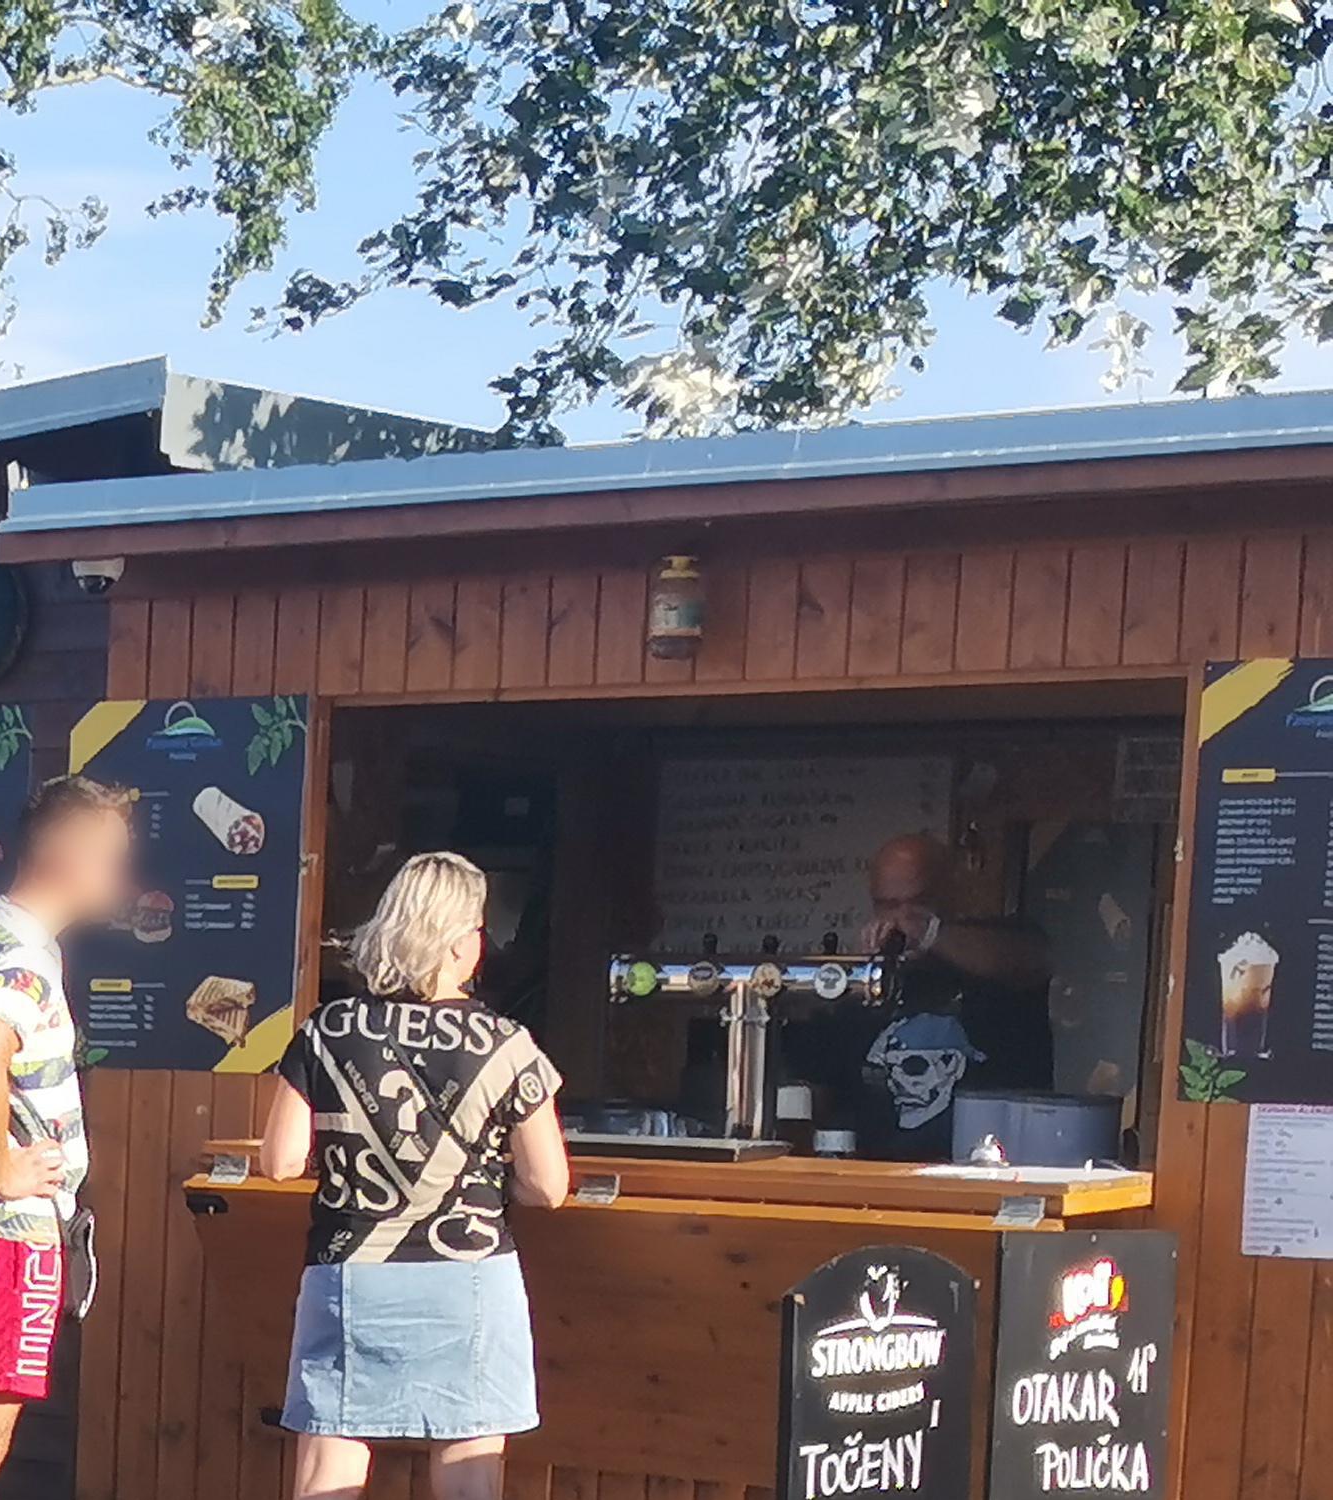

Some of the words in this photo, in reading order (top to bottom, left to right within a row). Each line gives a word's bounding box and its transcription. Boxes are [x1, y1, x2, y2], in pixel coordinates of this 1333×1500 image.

[320, 997, 495, 1055] GUESS
[811, 1329, 946, 1377] STRONGBOW
[1013, 1369, 1120, 1427] OTAKAR
[799, 1400, 941, 1500] TOČENÝ
[1035, 1434, 1149, 1491] POLIČKA
